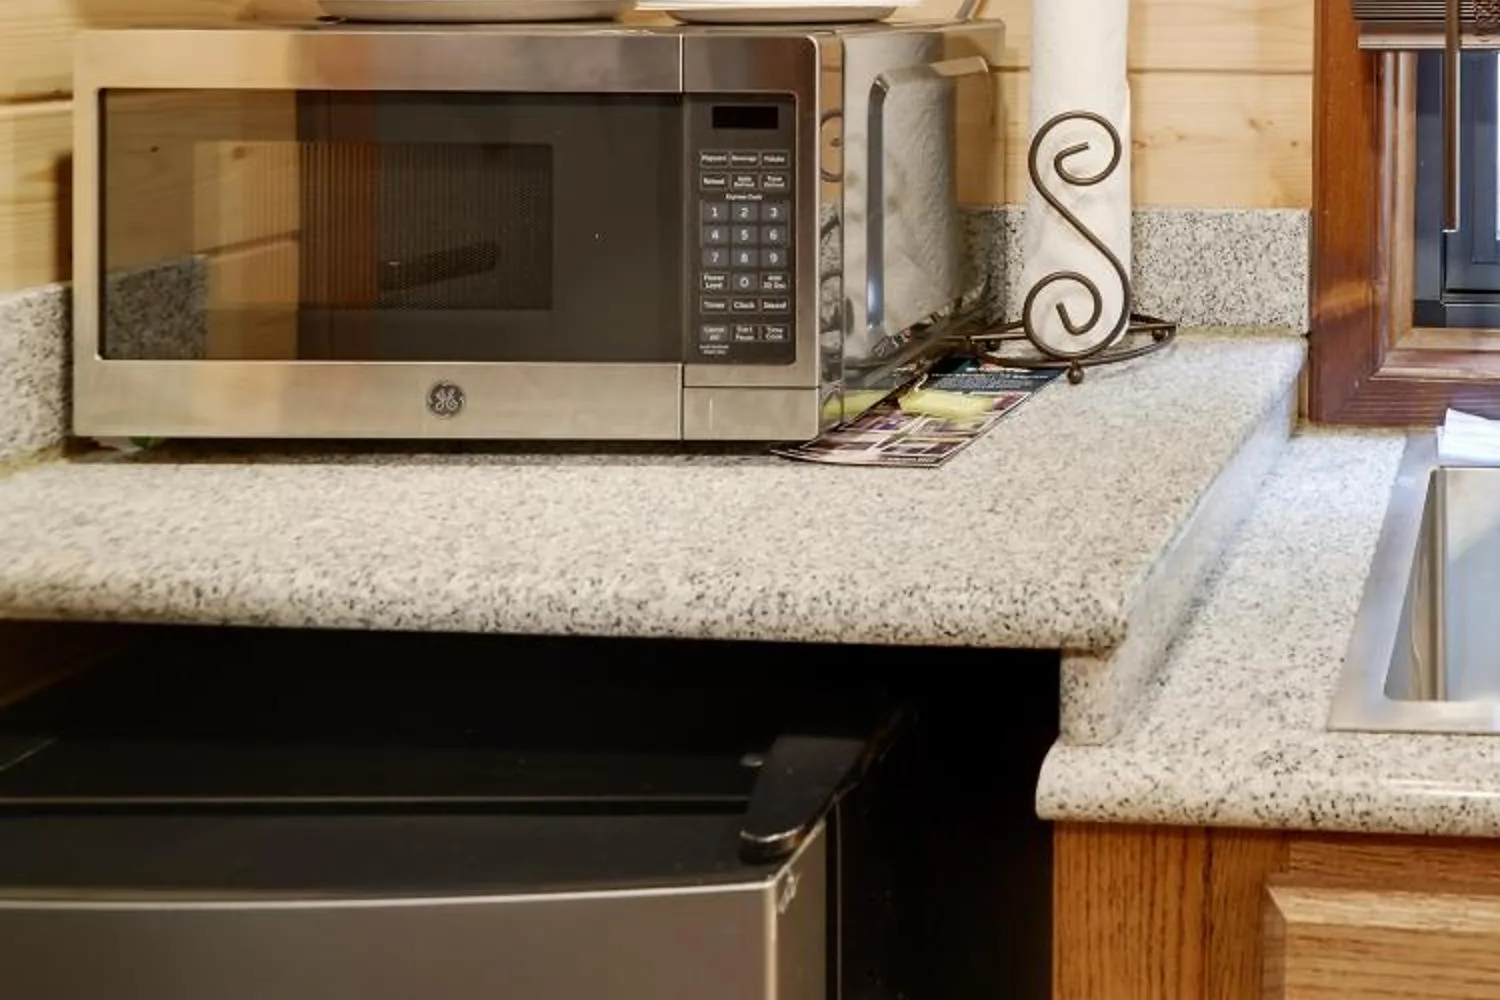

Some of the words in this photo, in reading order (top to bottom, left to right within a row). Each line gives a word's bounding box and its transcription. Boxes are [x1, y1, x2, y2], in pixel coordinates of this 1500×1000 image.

[711, 207, 719, 218] 1
[740, 207, 749, 218] 2
[769, 207, 778, 218] 3
[741, 229, 749, 241] 5
[769, 229, 778, 241] 6
[711, 252, 719, 263] 7
[740, 252, 749, 264] 8
[769, 252, 778, 264] 9
[740, 277, 749, 288] 0
